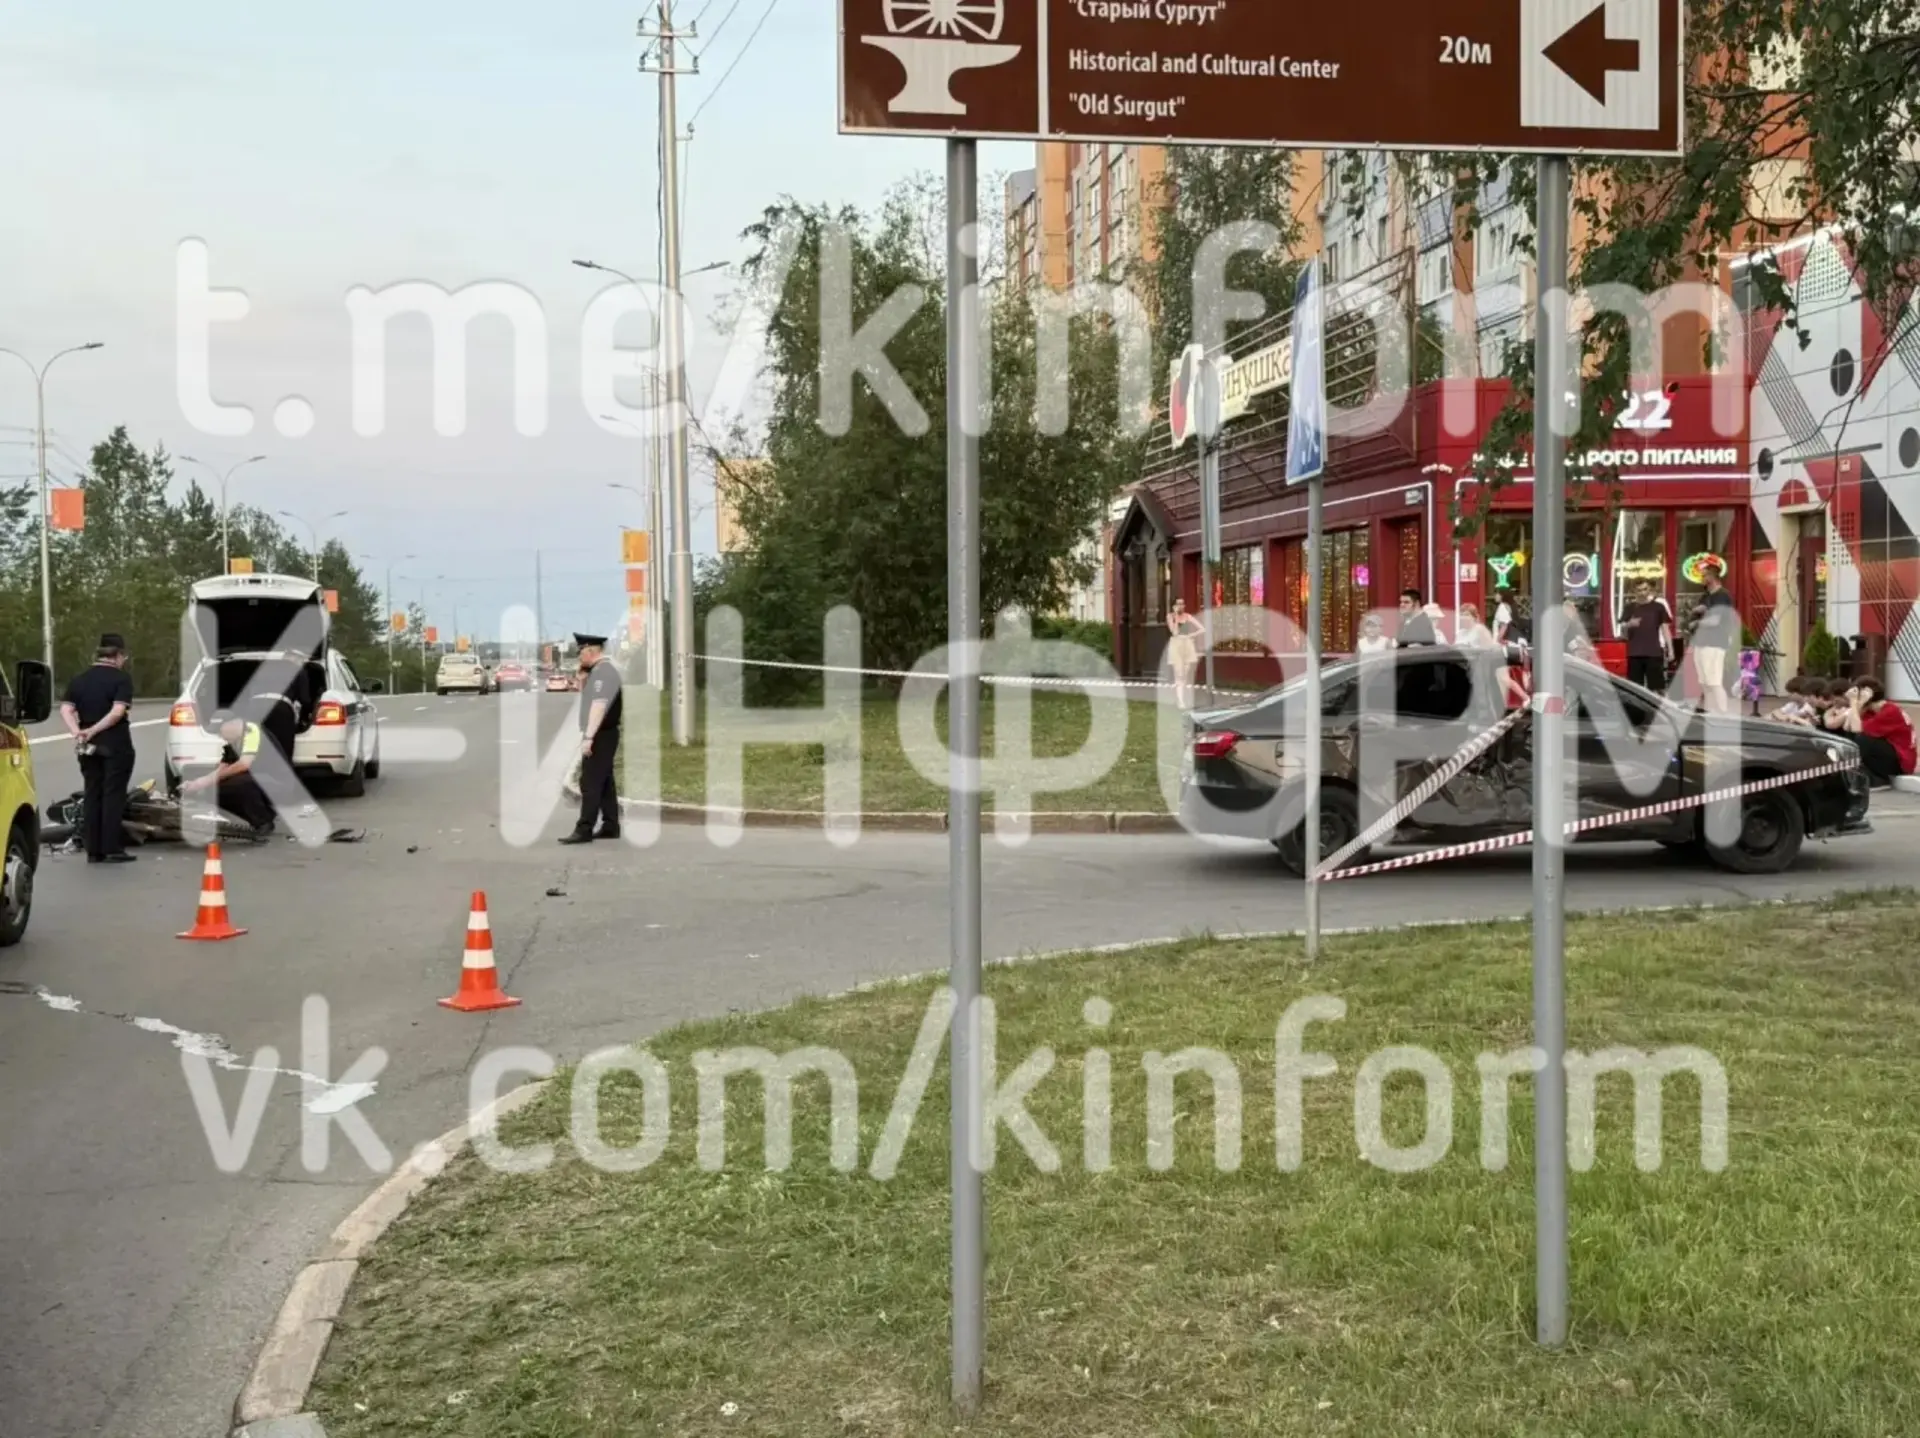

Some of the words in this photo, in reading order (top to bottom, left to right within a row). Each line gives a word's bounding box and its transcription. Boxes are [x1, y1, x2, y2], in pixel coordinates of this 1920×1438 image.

[1155, 0, 1226, 26] Сургут"
[1069, 49, 1157, 73] Historical
[1162, 53, 1197, 74] and
[1202, 54, 1275, 76] Cultural
[1280, 56, 1340, 79] Center
[1069, 92, 1109, 115] "Old
[1114, 95, 1186, 121] Surgut"
[1642, 448, 1738, 465] ПИТАНИЯ
